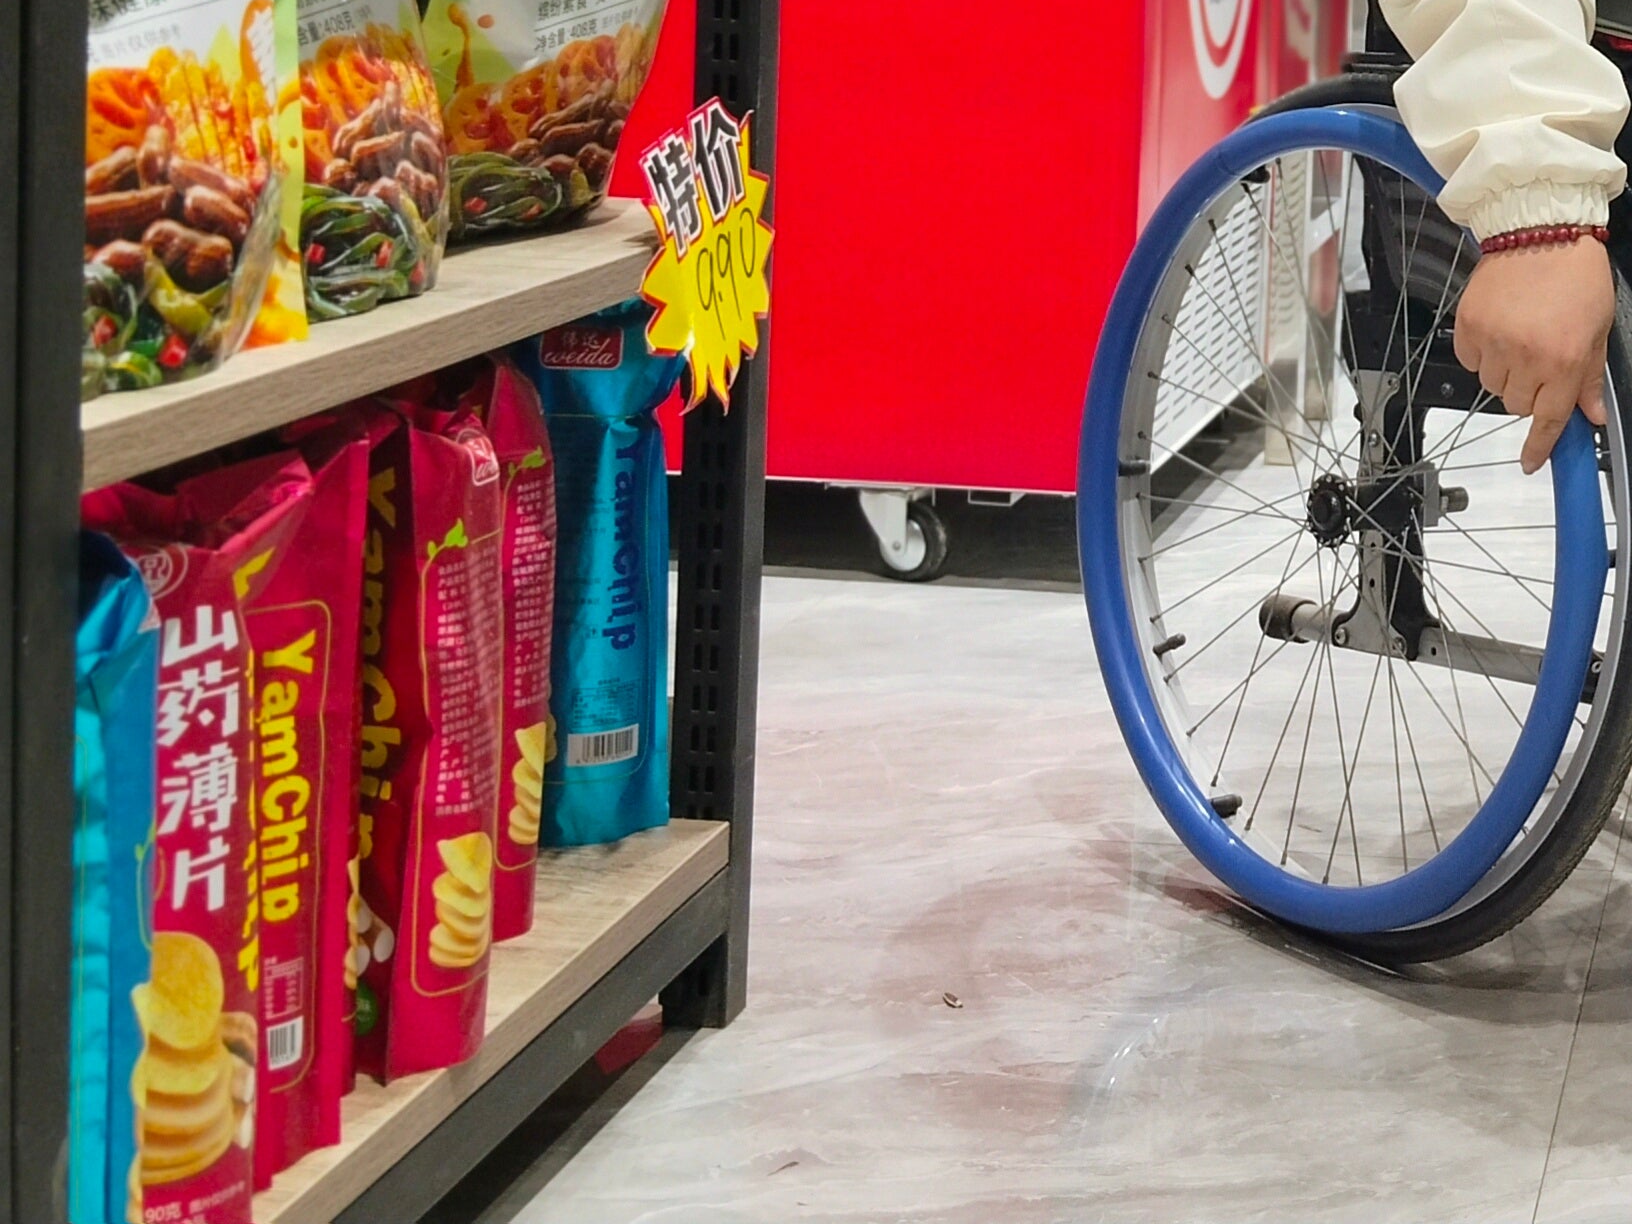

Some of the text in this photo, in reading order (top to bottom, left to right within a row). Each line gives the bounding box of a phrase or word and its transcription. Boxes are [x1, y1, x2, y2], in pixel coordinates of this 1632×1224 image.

[648, 101, 741, 254] 特价
[696, 207, 757, 341] 9.90
[543, 337, 616, 366] weida
[156, 605, 240, 912] 山药薄片
[261, 629, 316, 924] YamChip
